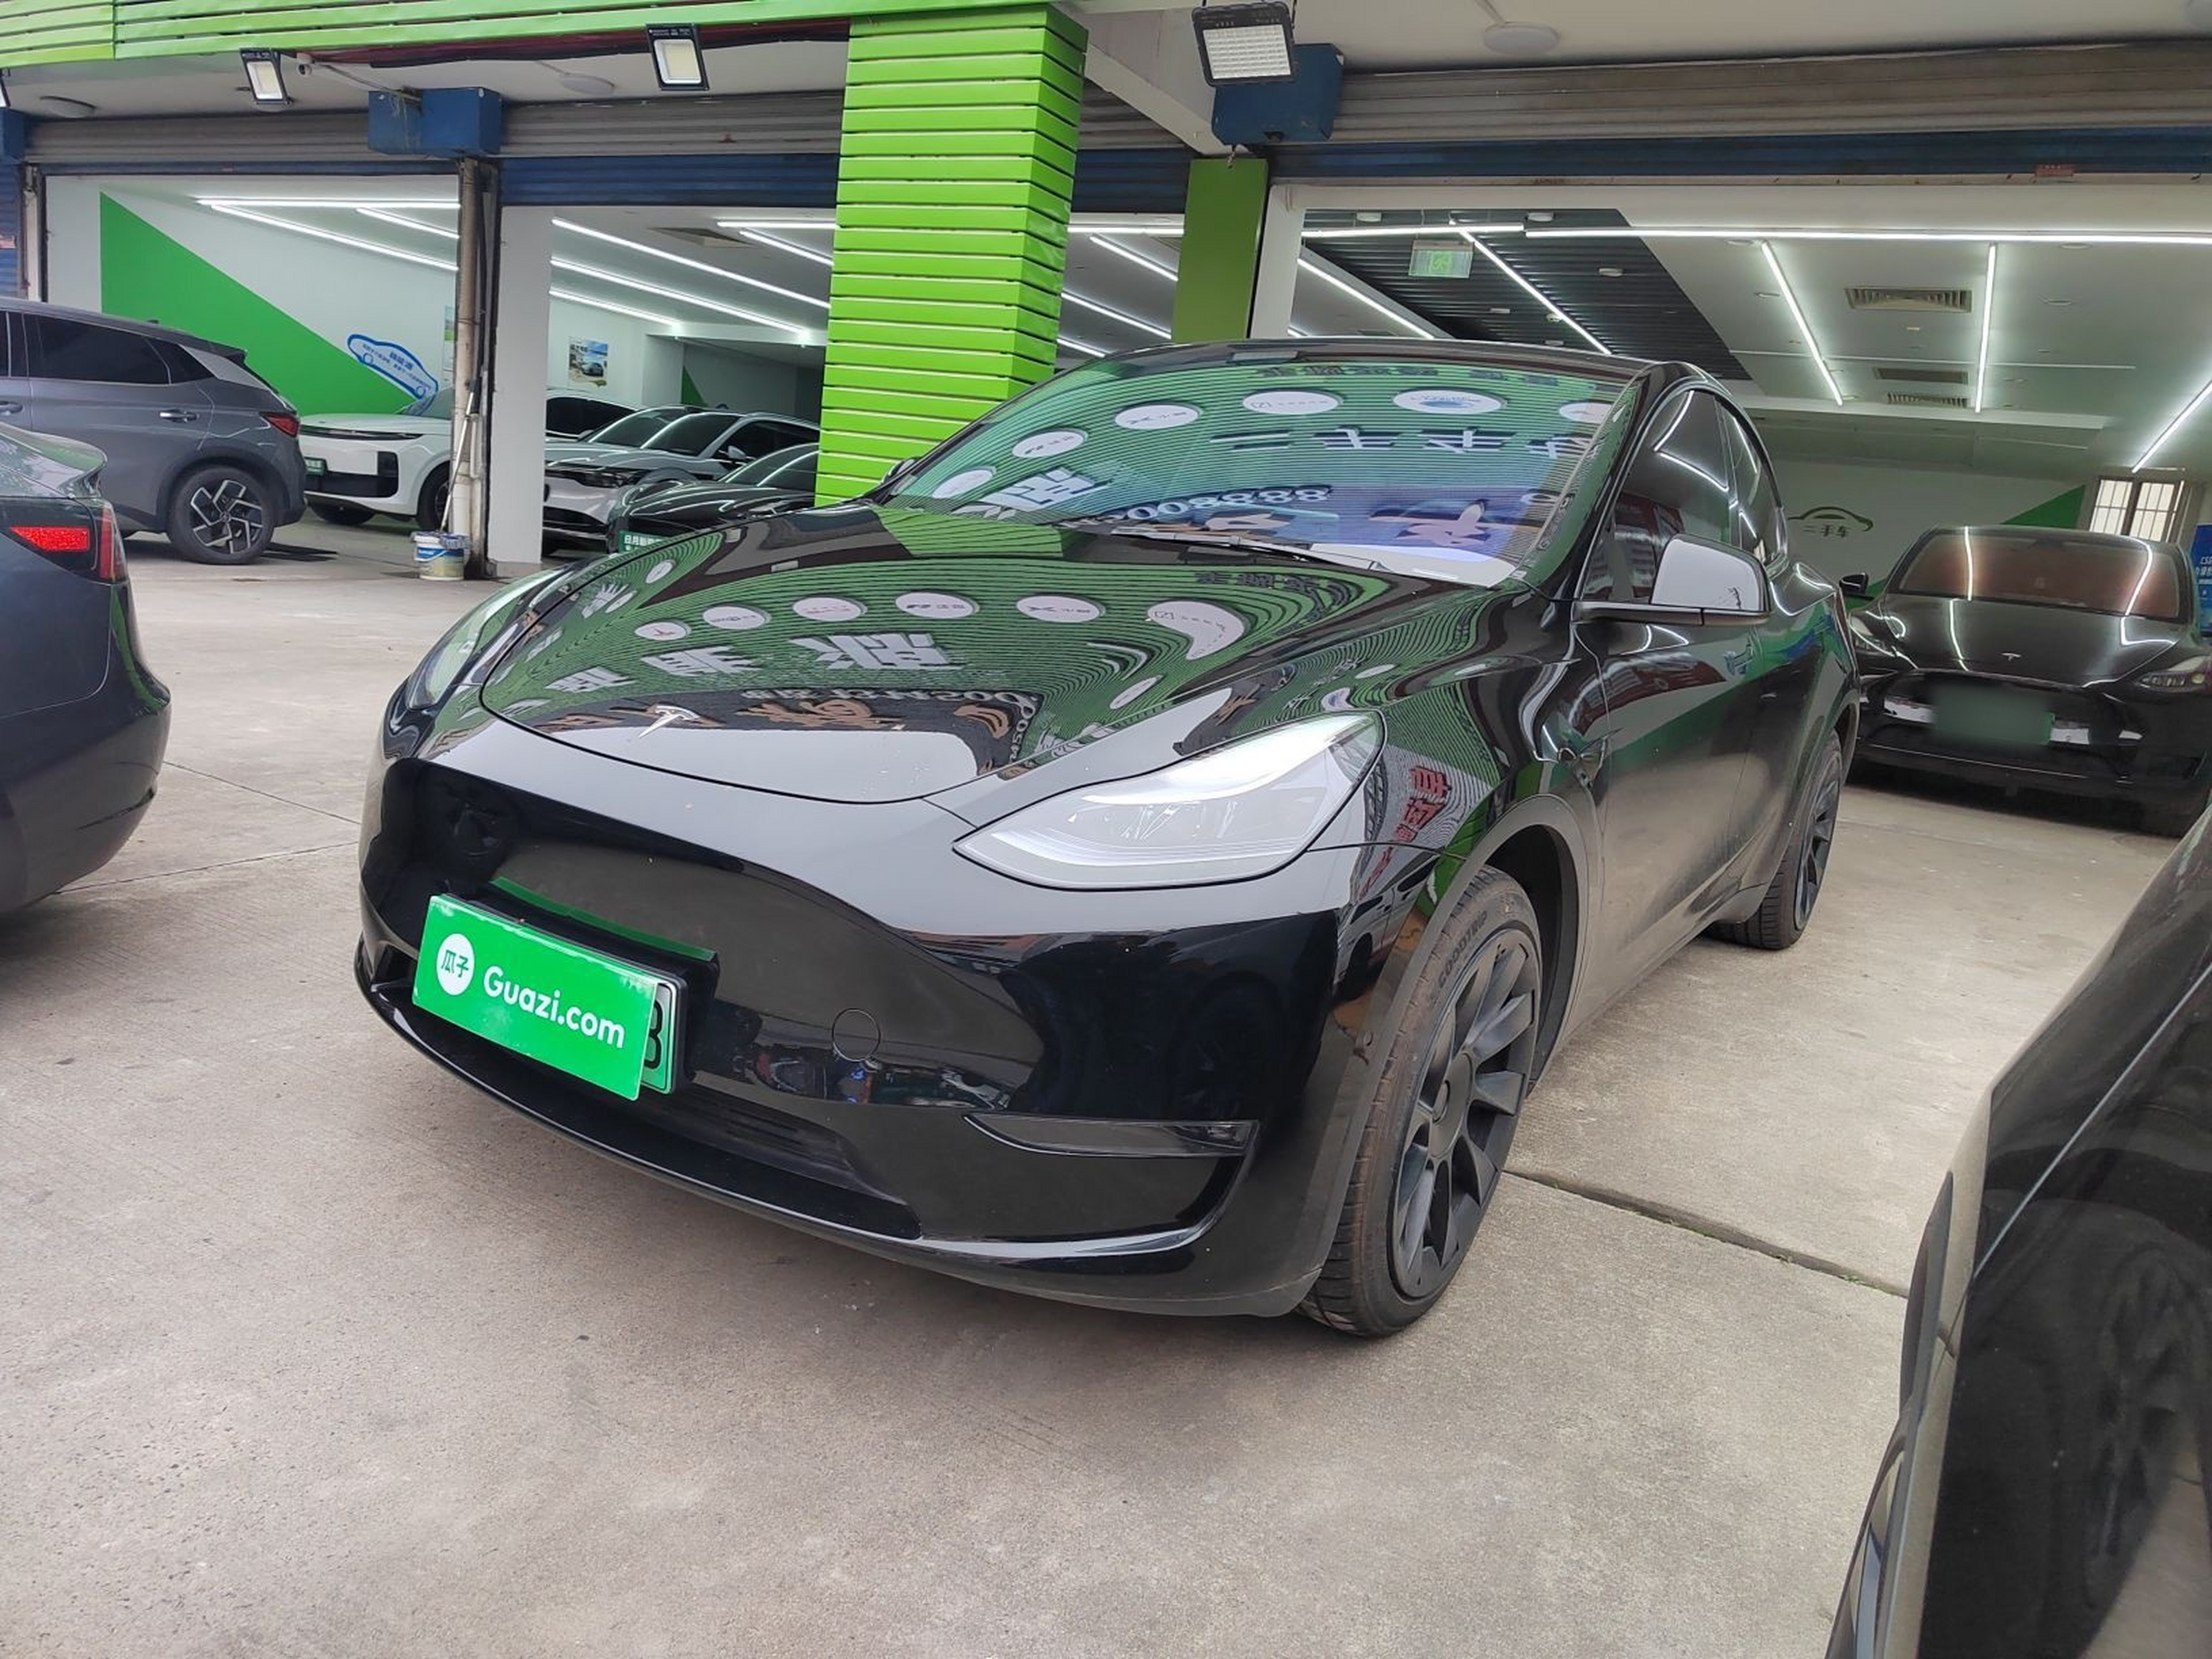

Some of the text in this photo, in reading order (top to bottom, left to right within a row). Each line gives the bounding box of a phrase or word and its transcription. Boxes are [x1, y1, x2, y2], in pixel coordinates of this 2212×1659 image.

[1803, 525, 1851, 537] 二手车
[441, 949, 469, 978] 瓜子
[483, 965, 625, 1048] Guazi.com
